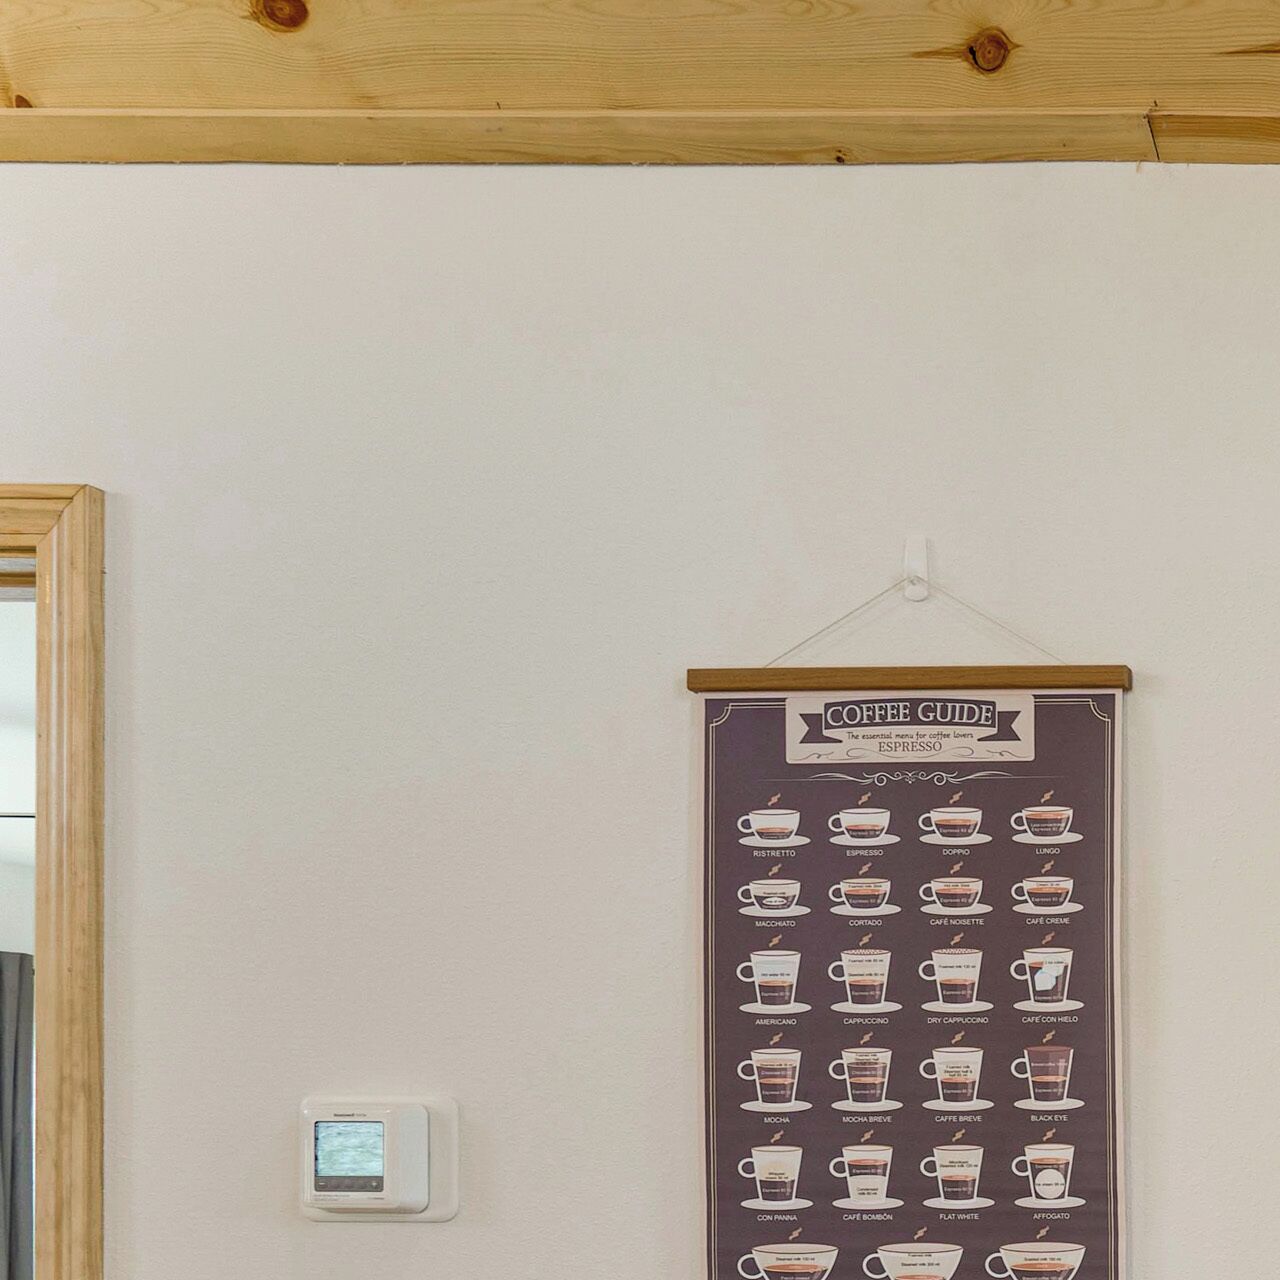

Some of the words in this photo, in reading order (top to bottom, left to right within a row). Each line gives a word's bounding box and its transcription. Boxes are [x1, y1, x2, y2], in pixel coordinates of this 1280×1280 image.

[826, 702, 911, 726] COFFEE
[917, 701, 993, 725] GUIDE
[847, 731, 860, 740] The
[861, 731, 893, 740] essential
[915, 731, 927, 741] for
[928, 730, 951, 741] coffee
[953, 730, 974, 739] lovers
[878, 741, 943, 753] ESPRESSO
[753, 849, 796, 857] RISTRETTO
[846, 849, 884, 857] ESPRESSO
[942, 848, 971, 856] DOPPIO
[1035, 847, 1061, 855] LUNGO
[755, 919, 796, 927] MACCHIATO
[848, 919, 883, 927] CORTADO
[950, 918, 985, 926] NOISETTE
[1046, 917, 1070, 925] CREME
[755, 1018, 798, 1026] AMERICANO
[843, 1017, 889, 1025] CAPPUCCINO
[927, 1017, 942, 1025] DRY
[943, 1016, 989, 1024] CAPPUCCINO
[1043, 1015, 1057, 1023] CON
[1057, 1015, 1079, 1023] HIELO
[764, 1116, 790, 1124] MOCHA
[868, 1115, 892, 1123] BREVE
[1031, 1114, 1053, 1122] BLACK
[757, 1214, 773, 1222] CON
[1033, 1212, 1070, 1220] AFFOGATO
